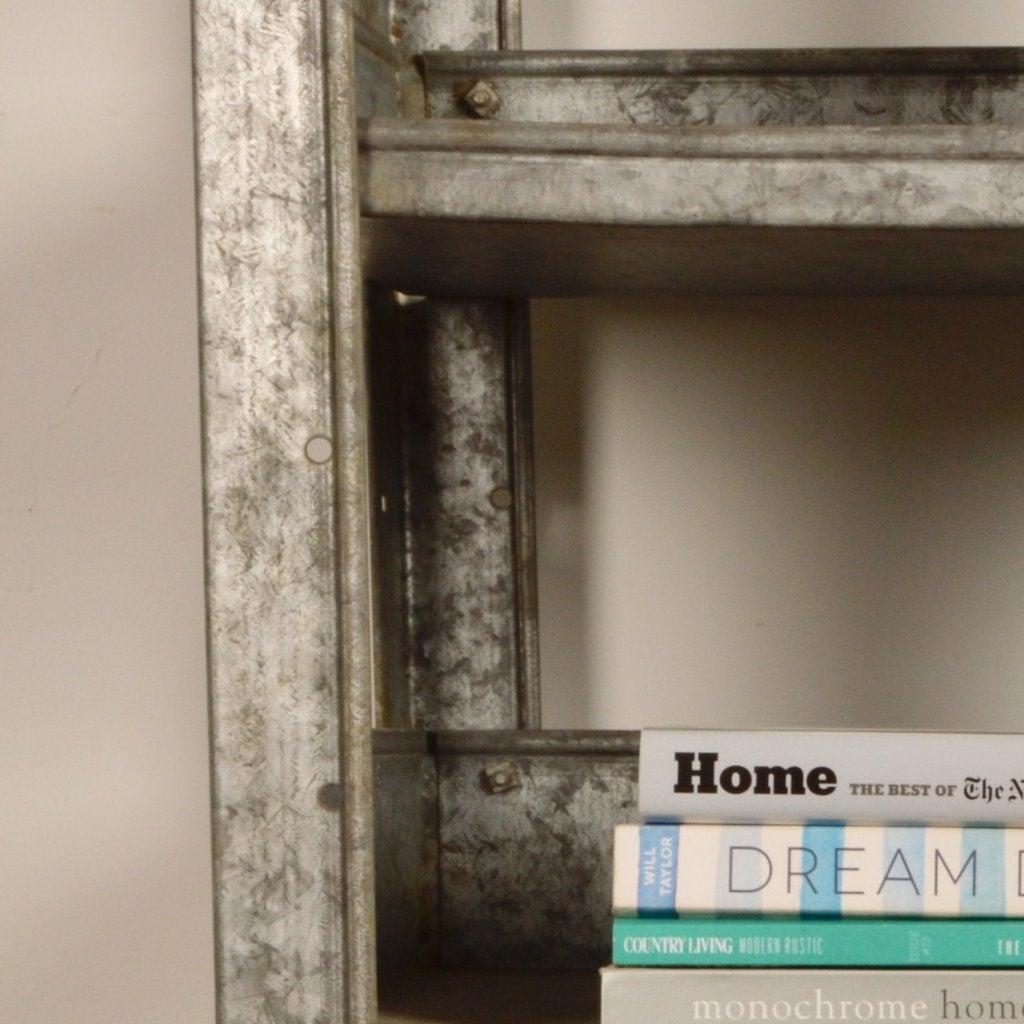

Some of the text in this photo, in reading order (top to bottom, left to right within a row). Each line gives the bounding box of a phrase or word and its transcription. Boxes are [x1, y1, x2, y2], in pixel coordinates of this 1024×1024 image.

[674, 752, 837, 795] Home
[850, 783, 885, 796] THE
[888, 783, 932, 797] BEST
[935, 784, 957, 797] OF
[964, 777, 1004, 803] The
[643, 847, 656, 885] WILL
[659, 836, 673, 898] TAYLOR
[729, 846, 977, 896] DREAM
[624, 937, 824, 955] COUNTRY LIVING MODERN RUSTIC
[998, 940, 1020, 956] THE
[693, 989, 928, 1020] monochrome
